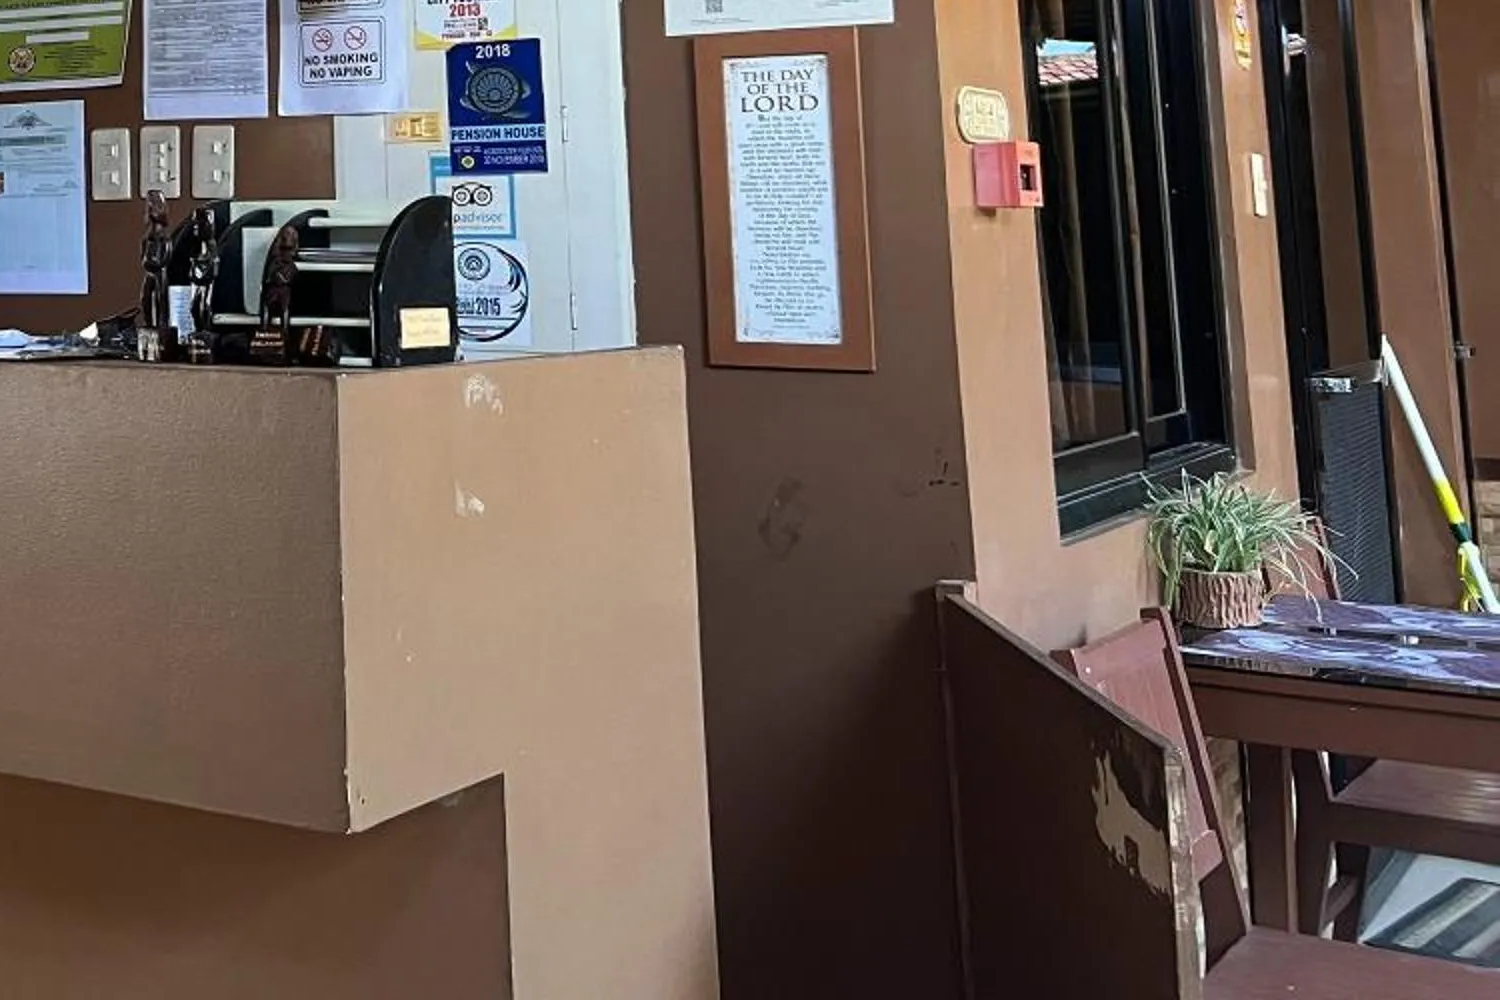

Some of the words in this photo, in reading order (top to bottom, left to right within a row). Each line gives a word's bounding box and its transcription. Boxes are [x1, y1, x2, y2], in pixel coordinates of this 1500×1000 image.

[449, 3, 481, 17] 2013
[304, 54, 321, 67] NO
[323, 51, 378, 65] SMOKING
[475, 44, 511, 59] 2018
[309, 67, 327, 80] NO
[328, 65, 372, 79] VAPING
[740, 70, 775, 83] THE
[781, 68, 814, 82] DAY
[747, 84, 769, 95] OF
[775, 82, 810, 94] THE
[740, 94, 819, 113] LORD
[452, 128, 500, 141] PENSION
[503, 126, 545, 139] HOUSE
[454, 212, 504, 224] padvisor
[475, 297, 501, 316] 2015
